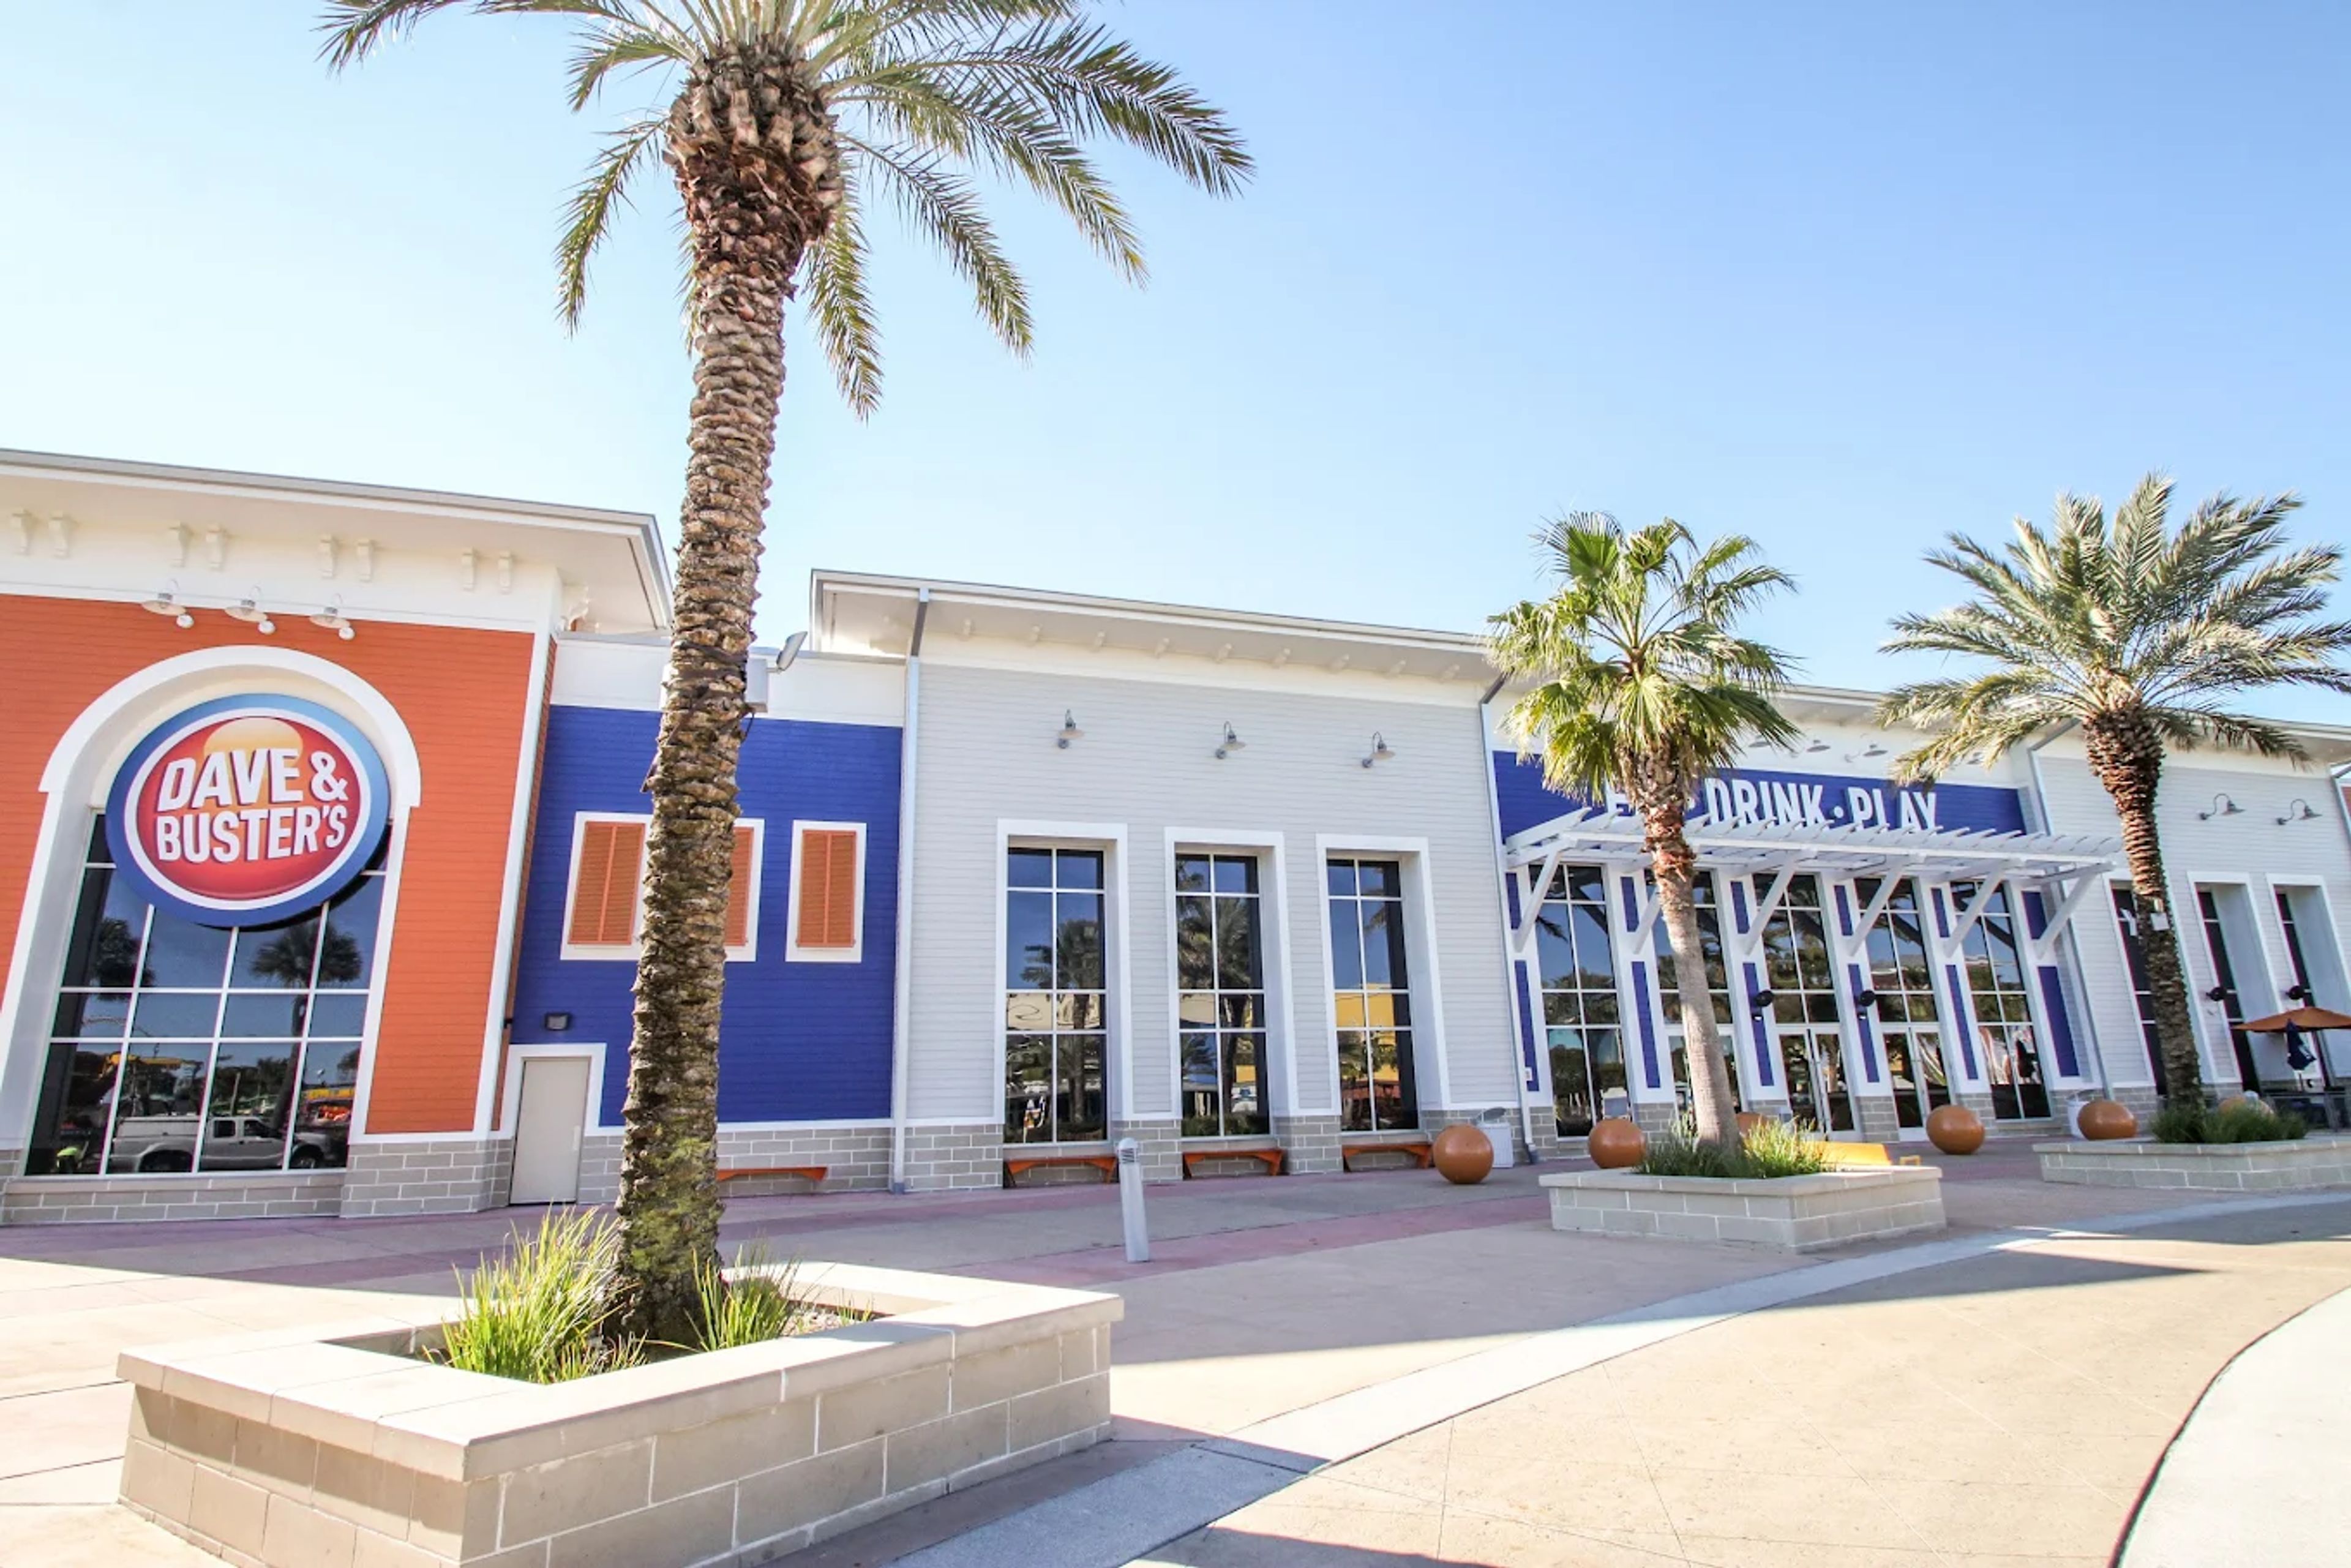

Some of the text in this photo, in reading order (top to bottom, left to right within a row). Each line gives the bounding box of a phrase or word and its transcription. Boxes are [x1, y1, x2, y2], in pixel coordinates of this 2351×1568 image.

[157, 748, 348, 812] DAVE &
[156, 805, 348, 863] BUSTER'S
